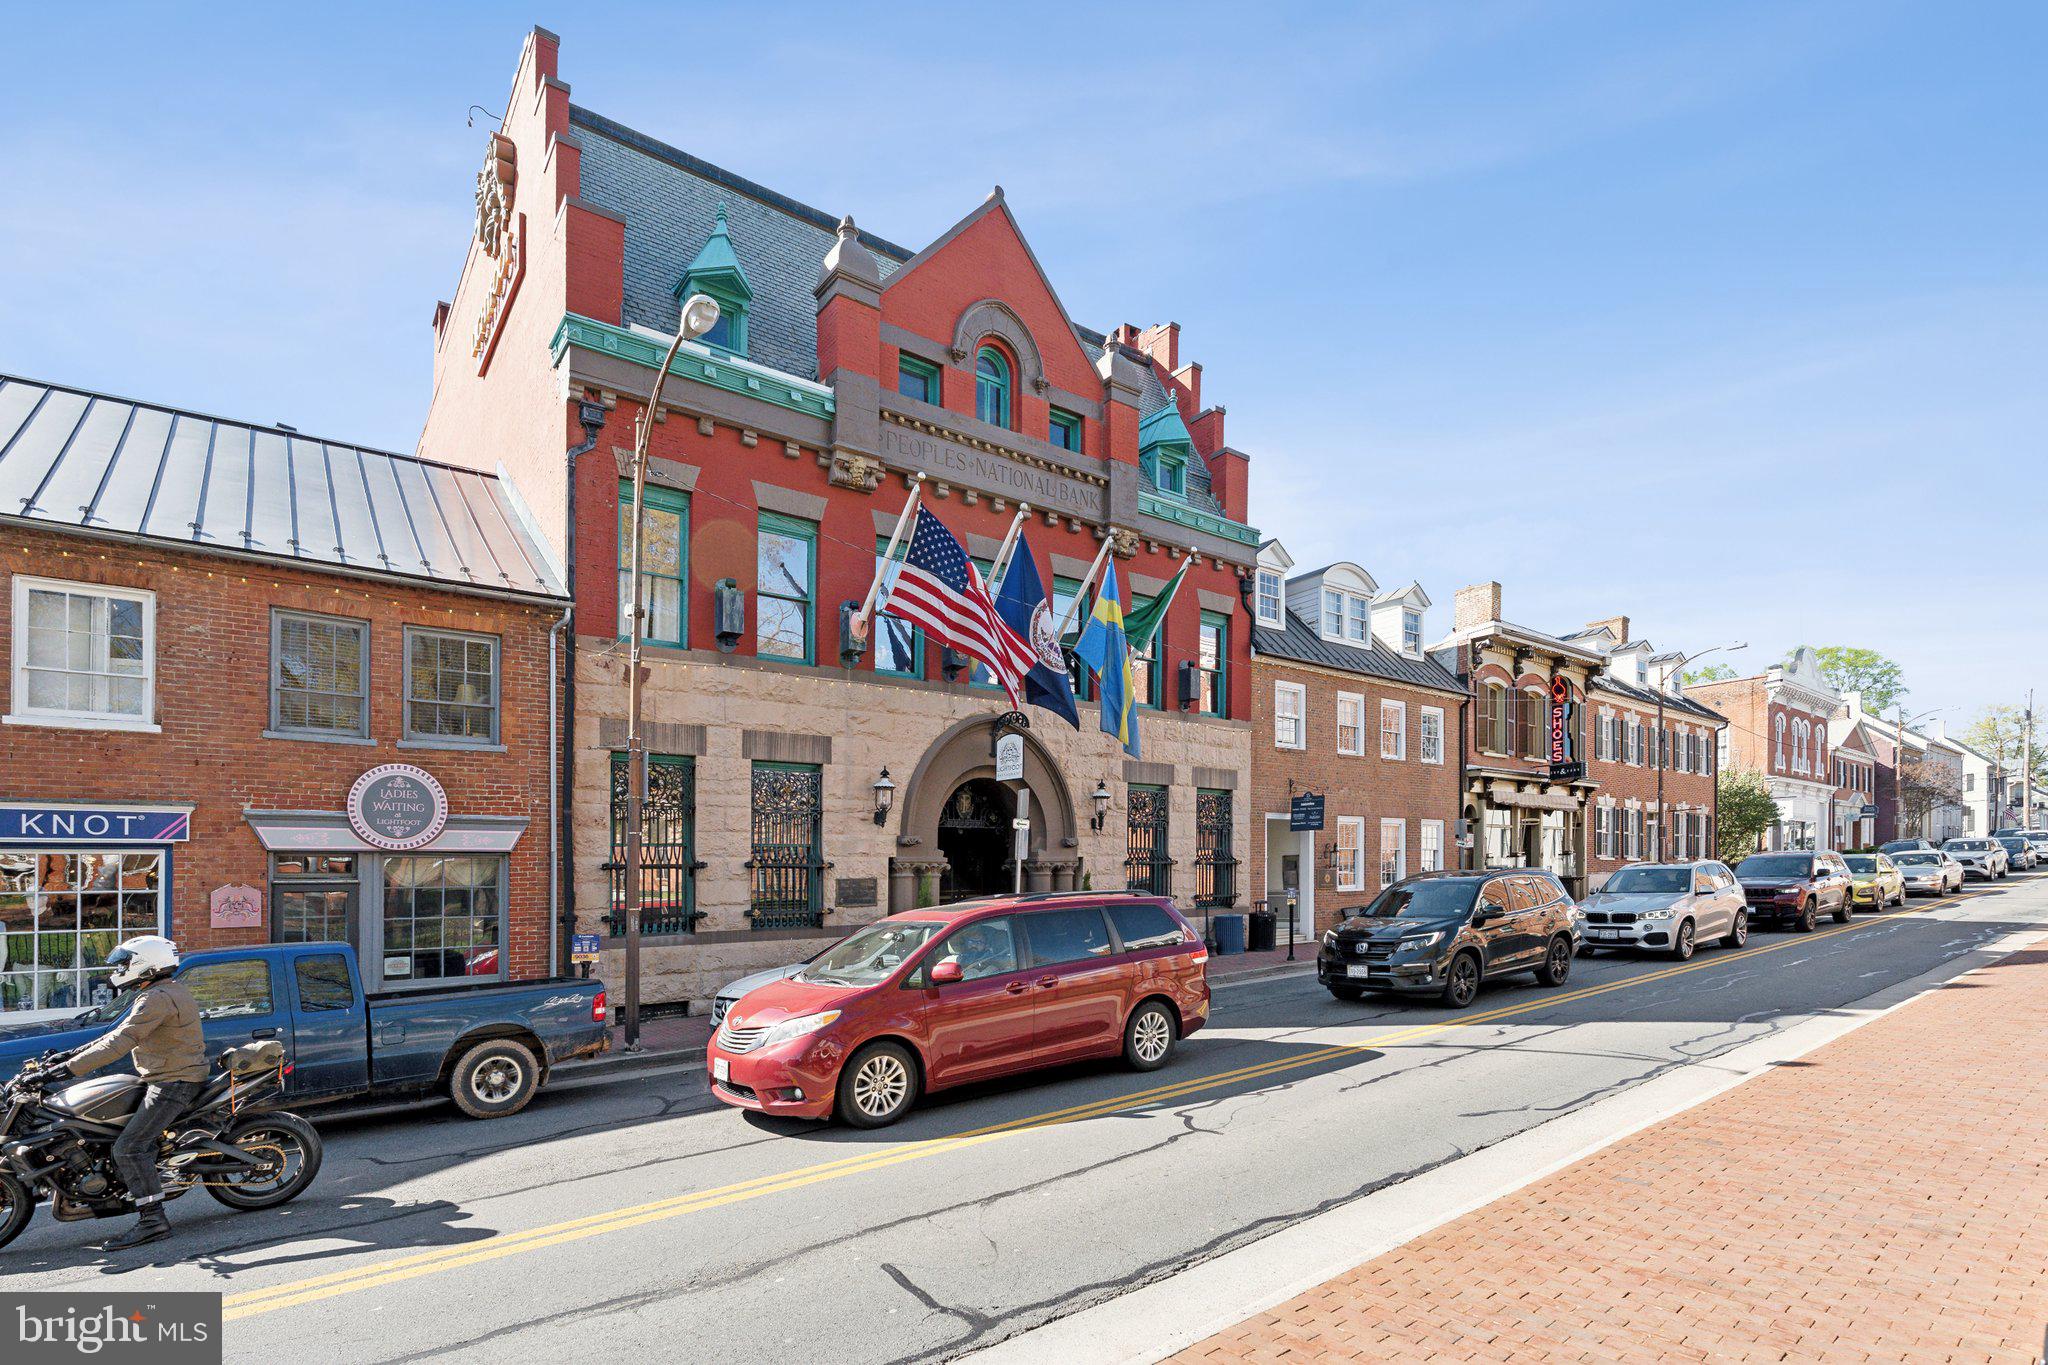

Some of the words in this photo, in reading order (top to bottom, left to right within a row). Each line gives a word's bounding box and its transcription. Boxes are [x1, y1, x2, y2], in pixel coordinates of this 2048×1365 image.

[886, 430, 967, 471] PEOPLES
[976, 457, 1056, 497] NATIONAL
[1060, 481, 1100, 511] BANK
[1552, 707, 1563, 762] SHOES
[380, 788, 419, 799] LADIES
[373, 800, 425, 812] WAITING
[376, 818, 421, 826] LIGHTFOOT
